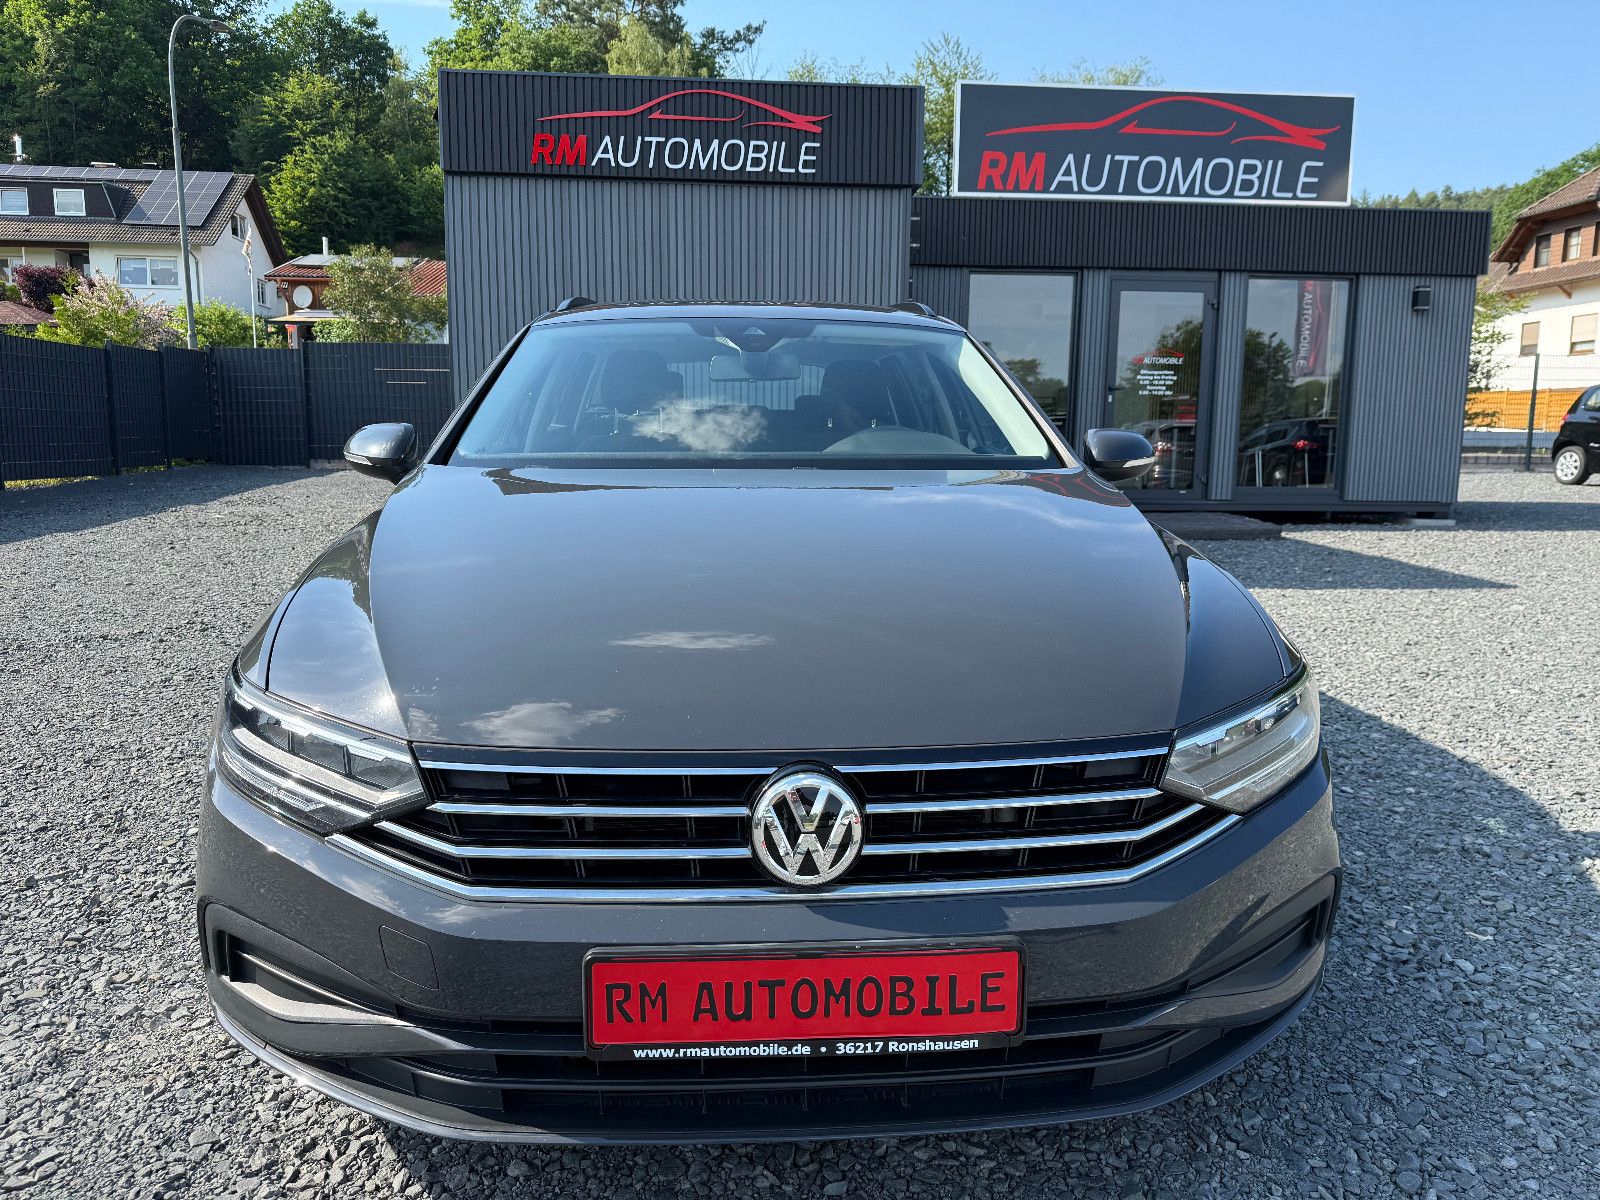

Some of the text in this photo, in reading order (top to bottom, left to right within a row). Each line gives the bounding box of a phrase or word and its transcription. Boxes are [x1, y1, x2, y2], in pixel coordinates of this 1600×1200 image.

[530, 133, 821, 174] RM AUTOMOBILE
[977, 150, 1324, 198] RM AUTOMOBILE
[1295, 292, 1313, 367] AUTOMOBILE
[1143, 356, 1184, 365] AUTOMOBILE
[605, 971, 1006, 1024] RM AUTOMOBILE
[633, 1038, 978, 1058] www.rmautomobile.de 36217 Ronshausen
